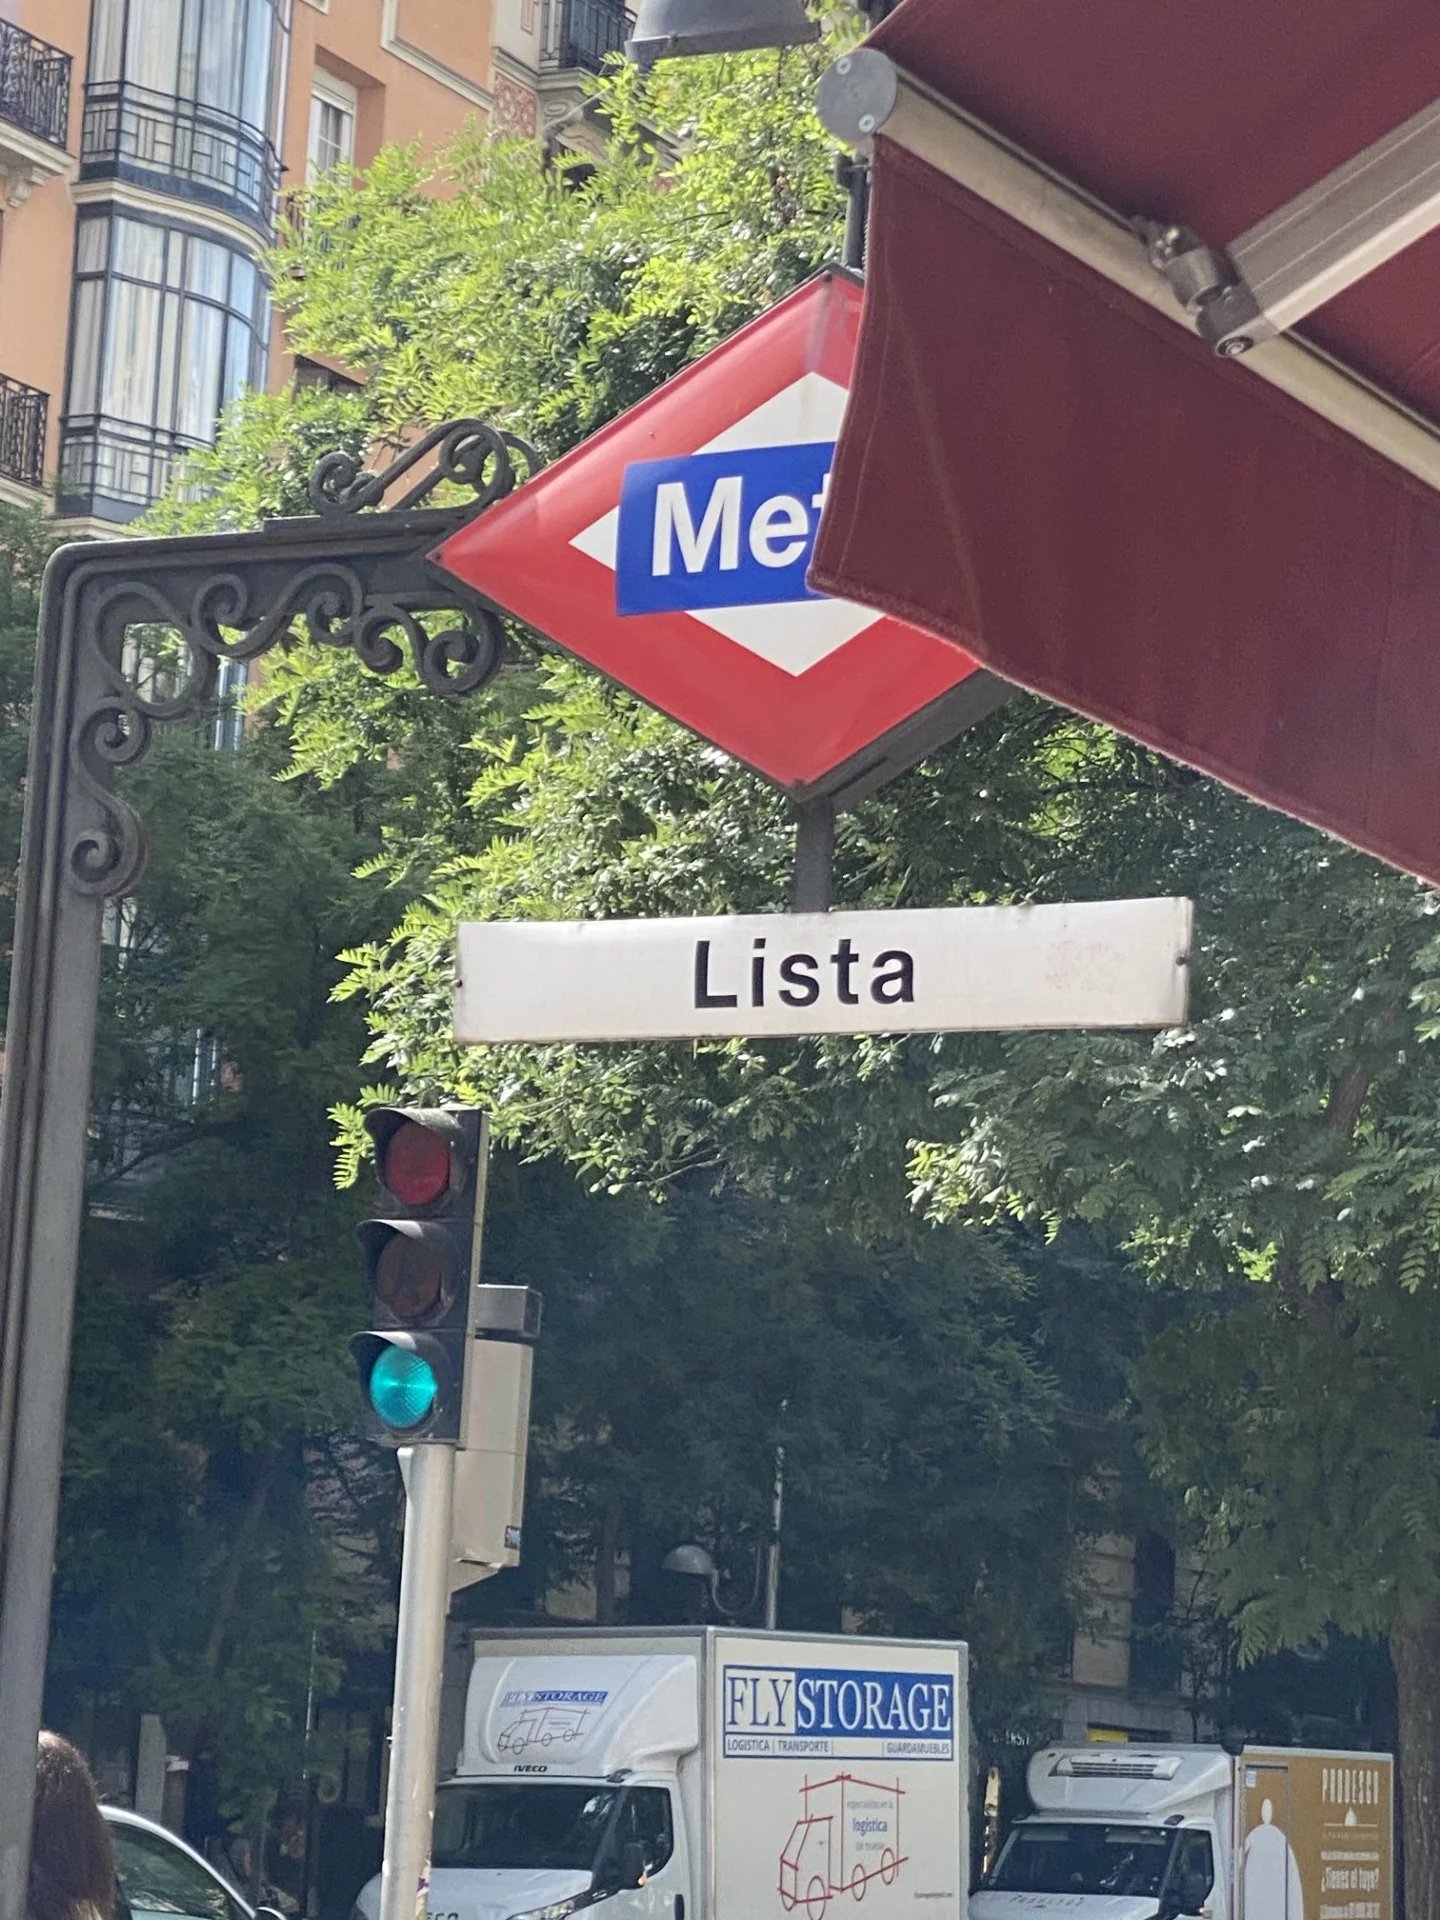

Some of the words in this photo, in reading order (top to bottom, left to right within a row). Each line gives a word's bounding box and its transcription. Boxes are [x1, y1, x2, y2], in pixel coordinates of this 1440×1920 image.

[693, 936, 916, 1009] Lista
[727, 1739, 770, 1752] LOGISTICA
[777, 1740, 829, 1753] TRANSPORTE
[886, 1742, 950, 1755] GUARDAMUEBLES
[513, 1764, 548, 1773] IVECO
